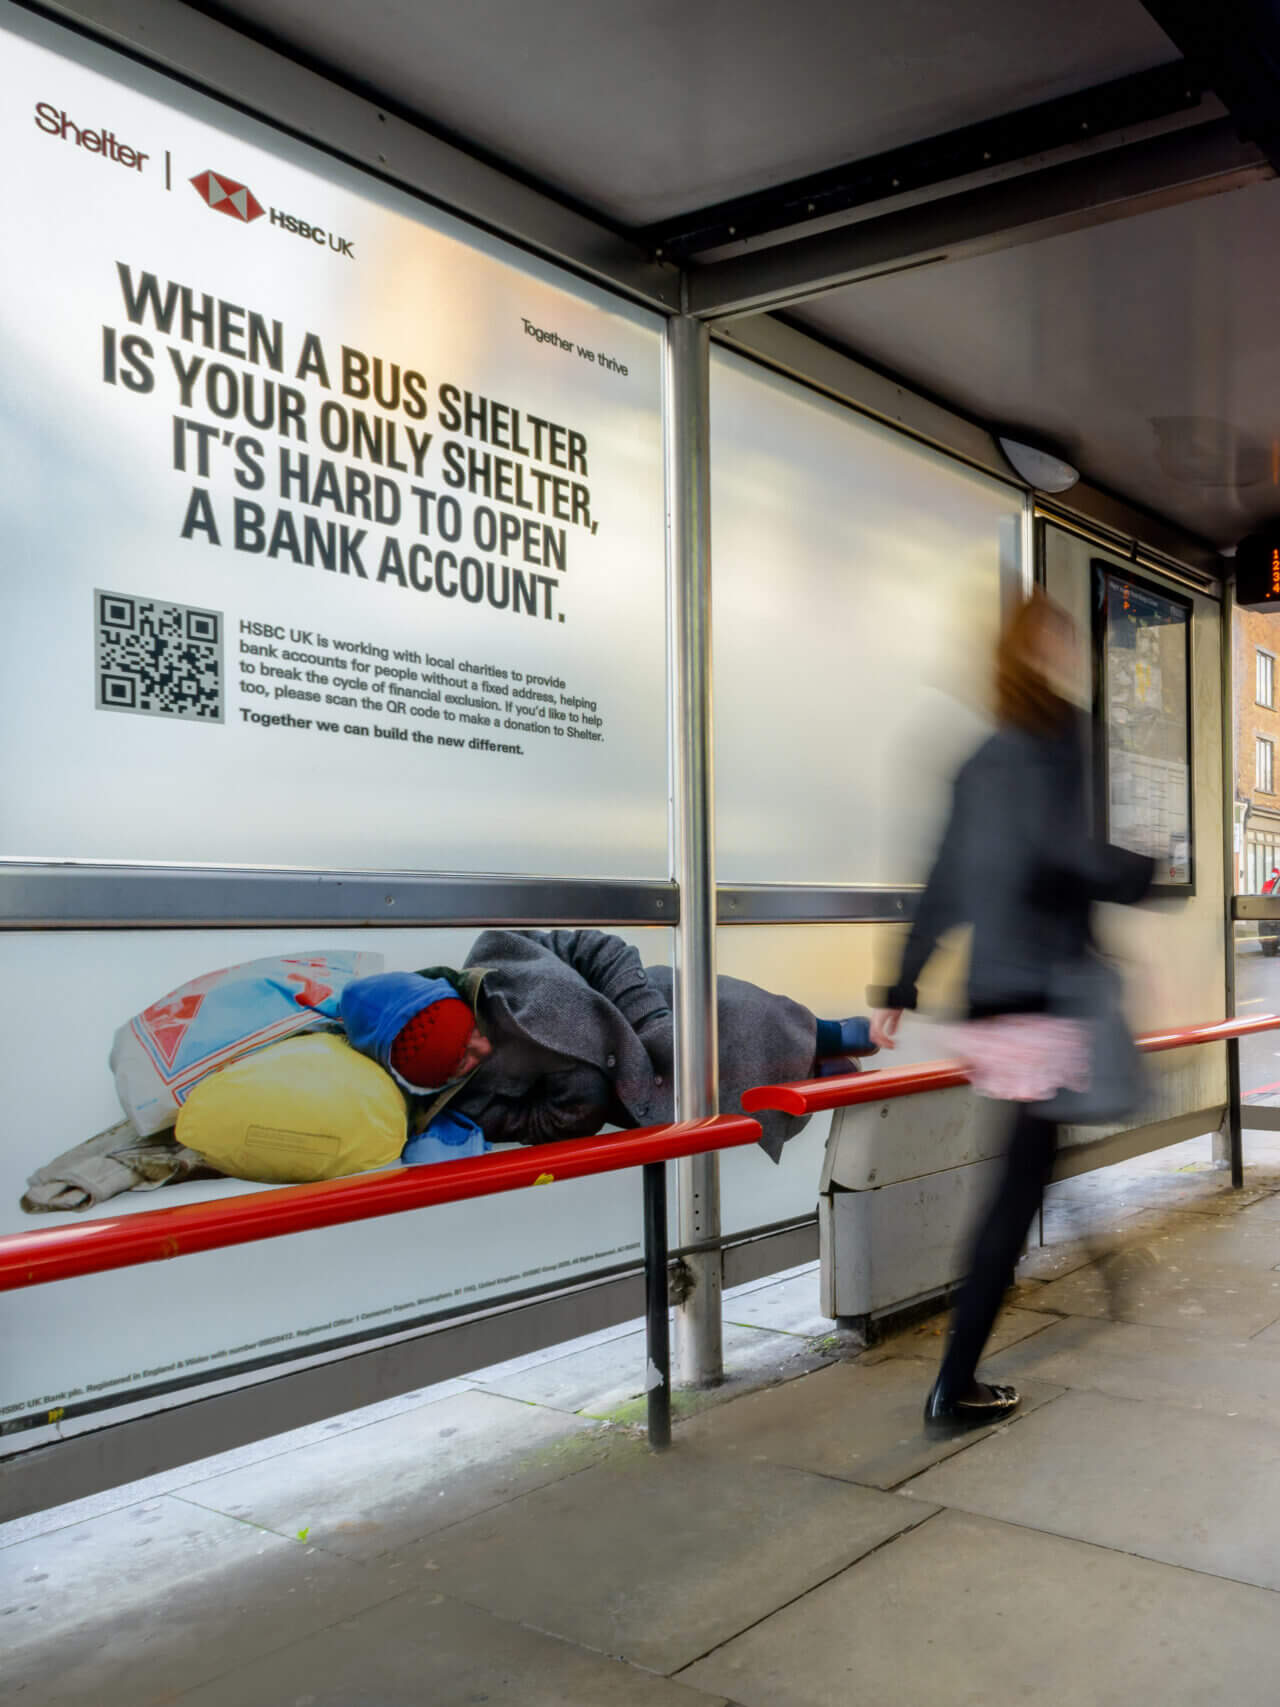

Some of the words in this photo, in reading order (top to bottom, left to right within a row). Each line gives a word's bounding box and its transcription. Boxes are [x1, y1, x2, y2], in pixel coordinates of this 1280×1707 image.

[34, 102, 150, 172] Shelter
[269, 207, 326, 245] HSBC
[328, 233, 355, 259] UK
[115, 260, 284, 373] WHEN
[295, 332, 331, 389] A
[341, 344, 427, 420] BUS
[437, 382, 588, 477] SHELTER
[521, 317, 575, 353] Together
[576, 345, 595, 362] we
[597, 352, 629, 376] thrive
[102, 324, 155, 394] IS
[166, 346, 307, 442] YOUR
[319, 400, 433, 478] ONLY
[442, 442, 600, 535] SHELTER,
[172, 415, 265, 492] IT'S
[279, 447, 402, 527] HARD
[410, 486, 462, 543] TO
[472, 516, 568, 572] OPEN
[180, 485, 222, 547] A
[233, 496, 368, 580] BANK
[376, 536, 566, 622] ACCOUNT.
[1272, 561, 1280, 571] 2
[1272, 572, 1280, 582] 3
[1273, 549, 1279, 560] 1
[1272, 583, 1280, 593] 4
[239, 619, 286, 641] HSBC
[290, 629, 314, 645] UK
[317, 634, 329, 648] is
[333, 639, 389, 661] working
[392, 650, 421, 664] with
[425, 653, 455, 670] local
[458, 661, 508, 680] charities
[511, 671, 523, 682] to
[526, 673, 566, 690] provide
[239, 640, 278, 658] bank
[282, 648, 348, 669] accounts
[351, 658, 371, 673] for
[374, 665, 418, 682] people
[421, 671, 468, 689] without
[471, 681, 478, 691] a
[481, 680, 509, 696] fixed
[512, 686, 557, 705] address,
[560, 693, 597, 712] helping
[239, 660, 256, 674] to
[260, 662, 302, 681] break
[305, 671, 329, 685] the
[332, 675, 368, 691] cycle
[371, 681, 386, 693] of
[388, 682, 441, 701] financial
[444, 692, 502, 712] exclusion.
[505, 701, 513, 713] If
[515, 704, 546, 718] you'd
[548, 709, 567, 721] like
[568, 713, 579, 723] to
[582, 715, 603, 728] help
[239, 680, 270, 697] too,
[274, 685, 321, 703] please
[325, 694, 358, 708] scan
[361, 697, 383, 712] the
[386, 700, 407, 715] QR
[410, 706, 441, 719] code
[443, 709, 456, 721] to
[459, 711, 491, 727] make
[494, 718, 501, 728] a
[503, 718, 551, 735] donation
[553, 726, 564, 737] to
[566, 727, 605, 742] Shelter.
[239, 708, 313, 730] Together
[316, 720, 340, 733] we
[343, 723, 370, 737] can
[373, 726, 408, 741] build
[411, 731, 434, 744] the
[437, 735, 465, 748] new
[468, 737, 525, 755] different.
